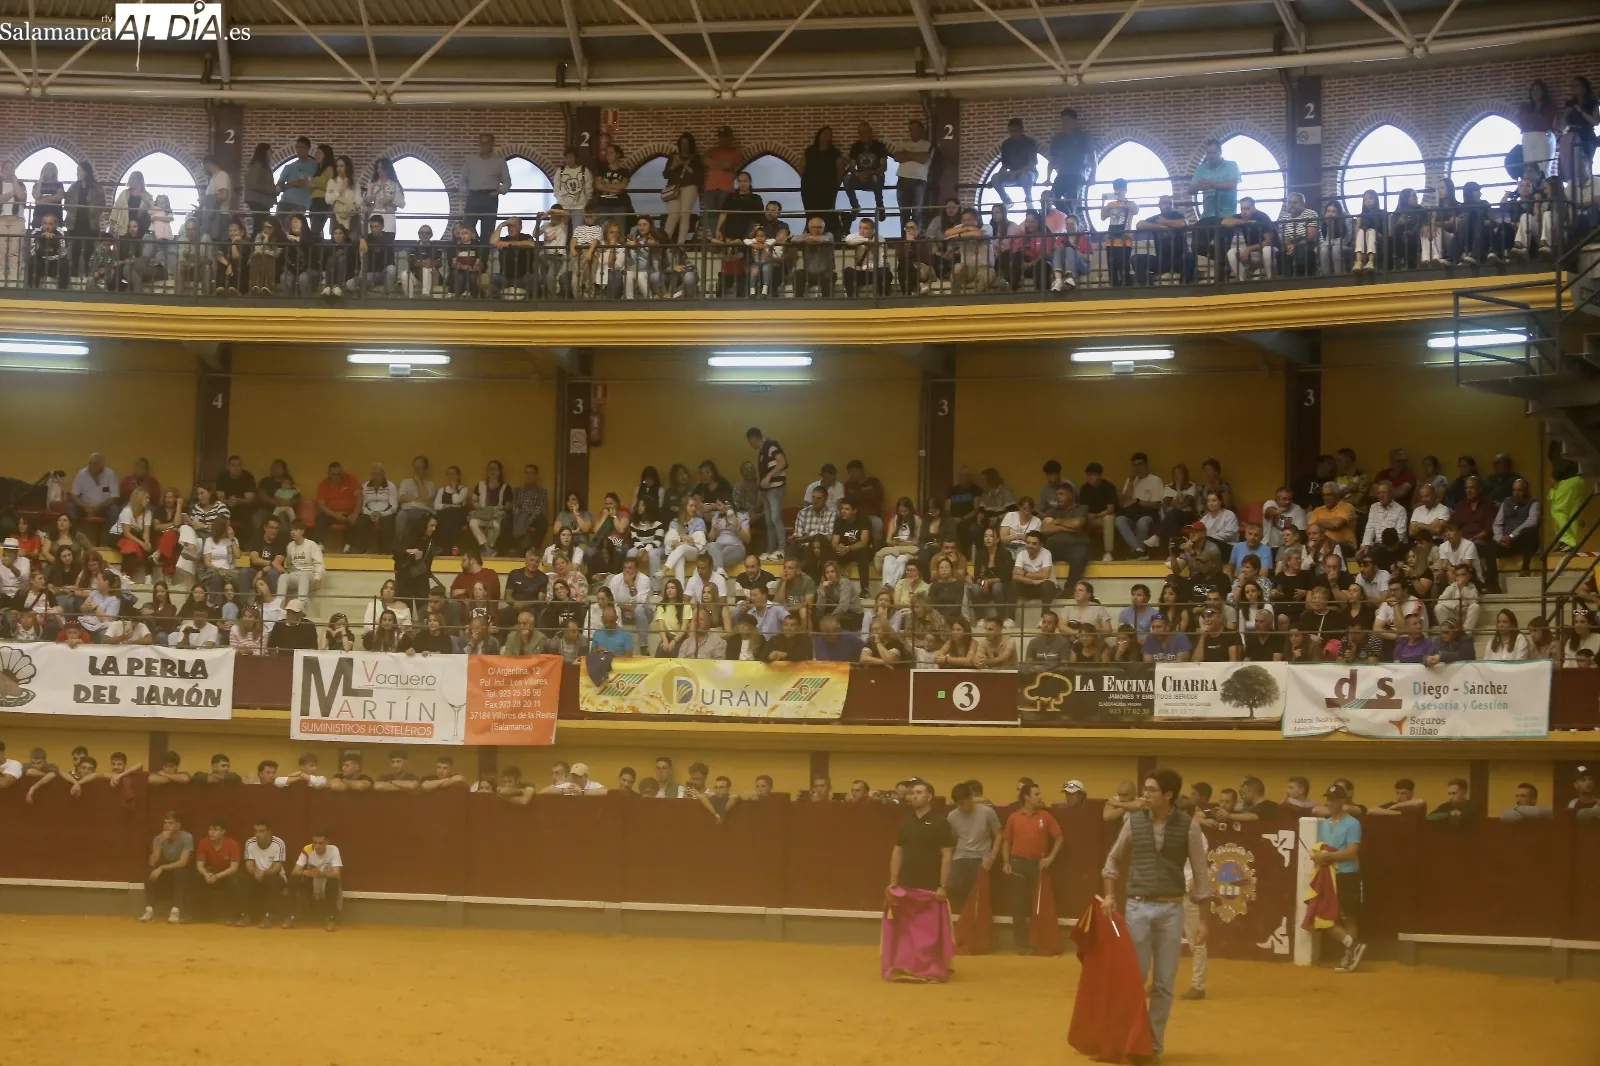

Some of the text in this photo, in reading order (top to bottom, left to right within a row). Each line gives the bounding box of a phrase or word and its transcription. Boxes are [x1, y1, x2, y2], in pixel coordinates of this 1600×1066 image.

[1304, 102, 1315, 120] 2
[224, 129, 236, 144] 2
[580, 132, 590, 146] 2
[942, 124, 954, 140] 2
[212, 393, 224, 408] 4
[1304, 389, 1315, 406] 3
[572, 398, 584, 414] 3
[938, 399, 949, 416] 3
[88, 655, 209, 679] LA PERLA
[362, 660, 437, 686] Vaquero
[1074, 675, 1218, 692] LA ENCINA CHARRA
[1412, 681, 1449, 699] Diego
[1463, 680, 1508, 695] Sánchez
[72, 682, 222, 708] DEL JAMÓN
[499, 690, 511, 698] 923
[522, 689, 530, 697] 35
[532, 689, 541, 697] 96
[959, 683, 975, 709] 3
[485, 701, 498, 709] Fax
[1463, 703, 1468, 712] y
[536, 711, 555, 719] Reina
[1410, 716, 1446, 726] Seguros
[301, 722, 432, 736] SUMINISTROS HOSTELEROS
[491, 722, 534, 732] (Salamanca)
[1409, 726, 1439, 736] Bilbao
